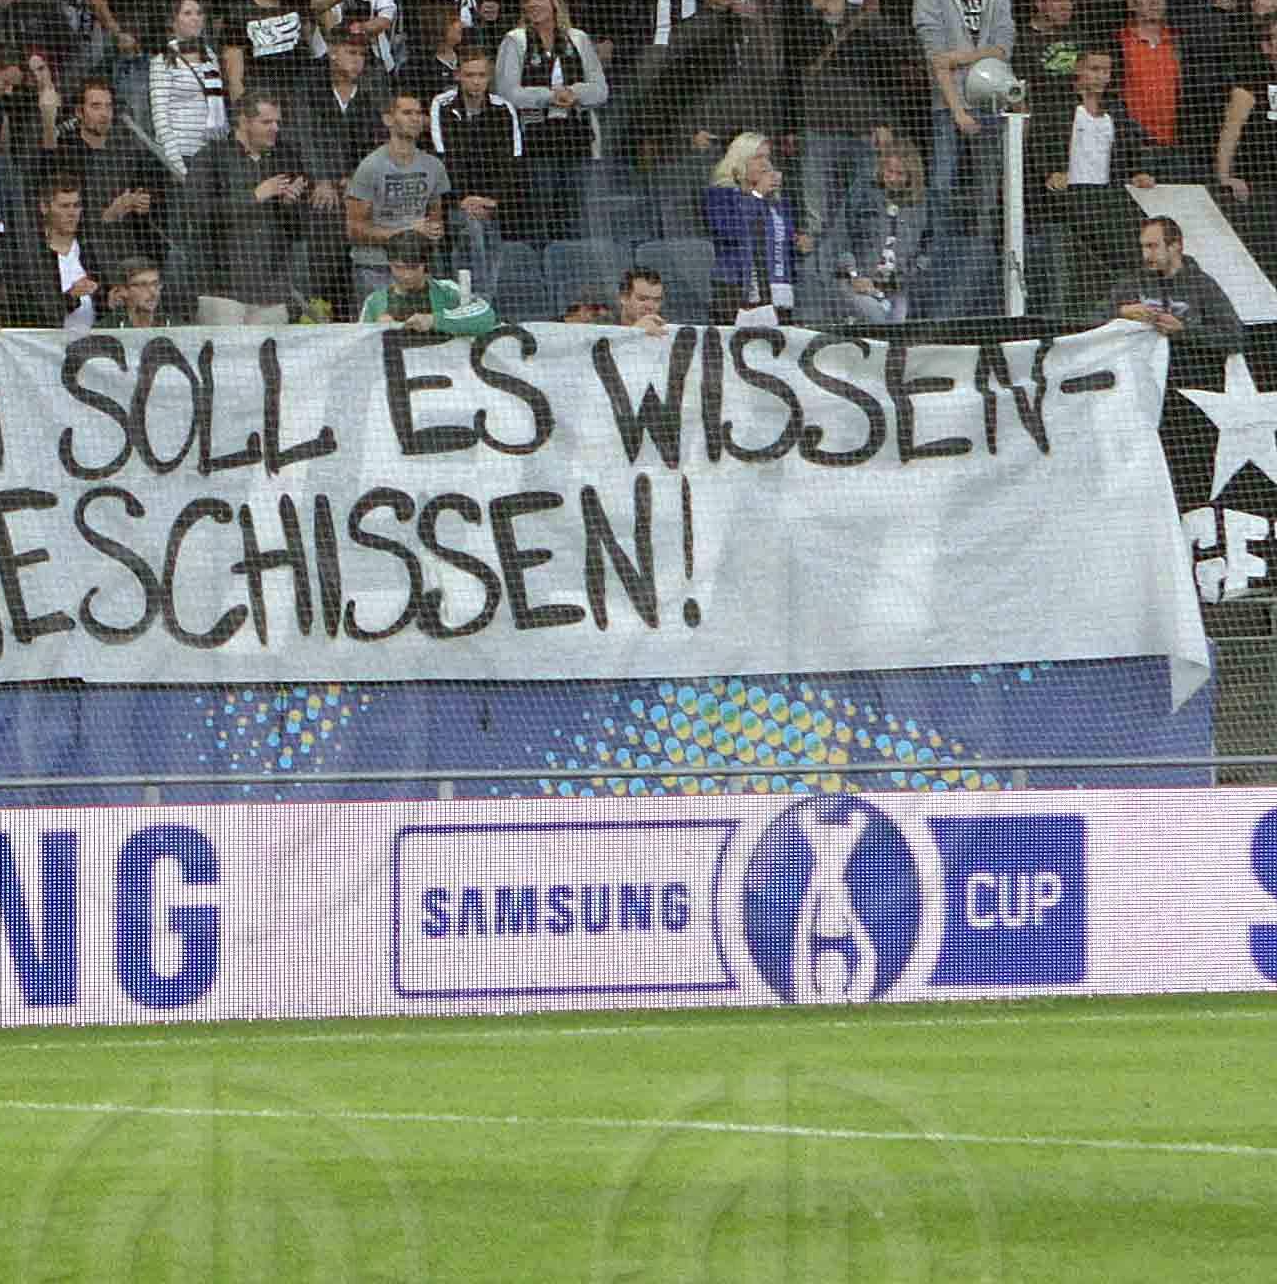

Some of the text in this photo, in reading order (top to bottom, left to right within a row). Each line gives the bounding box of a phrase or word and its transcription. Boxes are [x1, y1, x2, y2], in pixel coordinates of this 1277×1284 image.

[59, 336, 337, 480] SOLL
[381, 325, 556, 457] ES
[421, 880, 691, 939] SAMSUNG
[963, 869, 1063, 931] CUP
